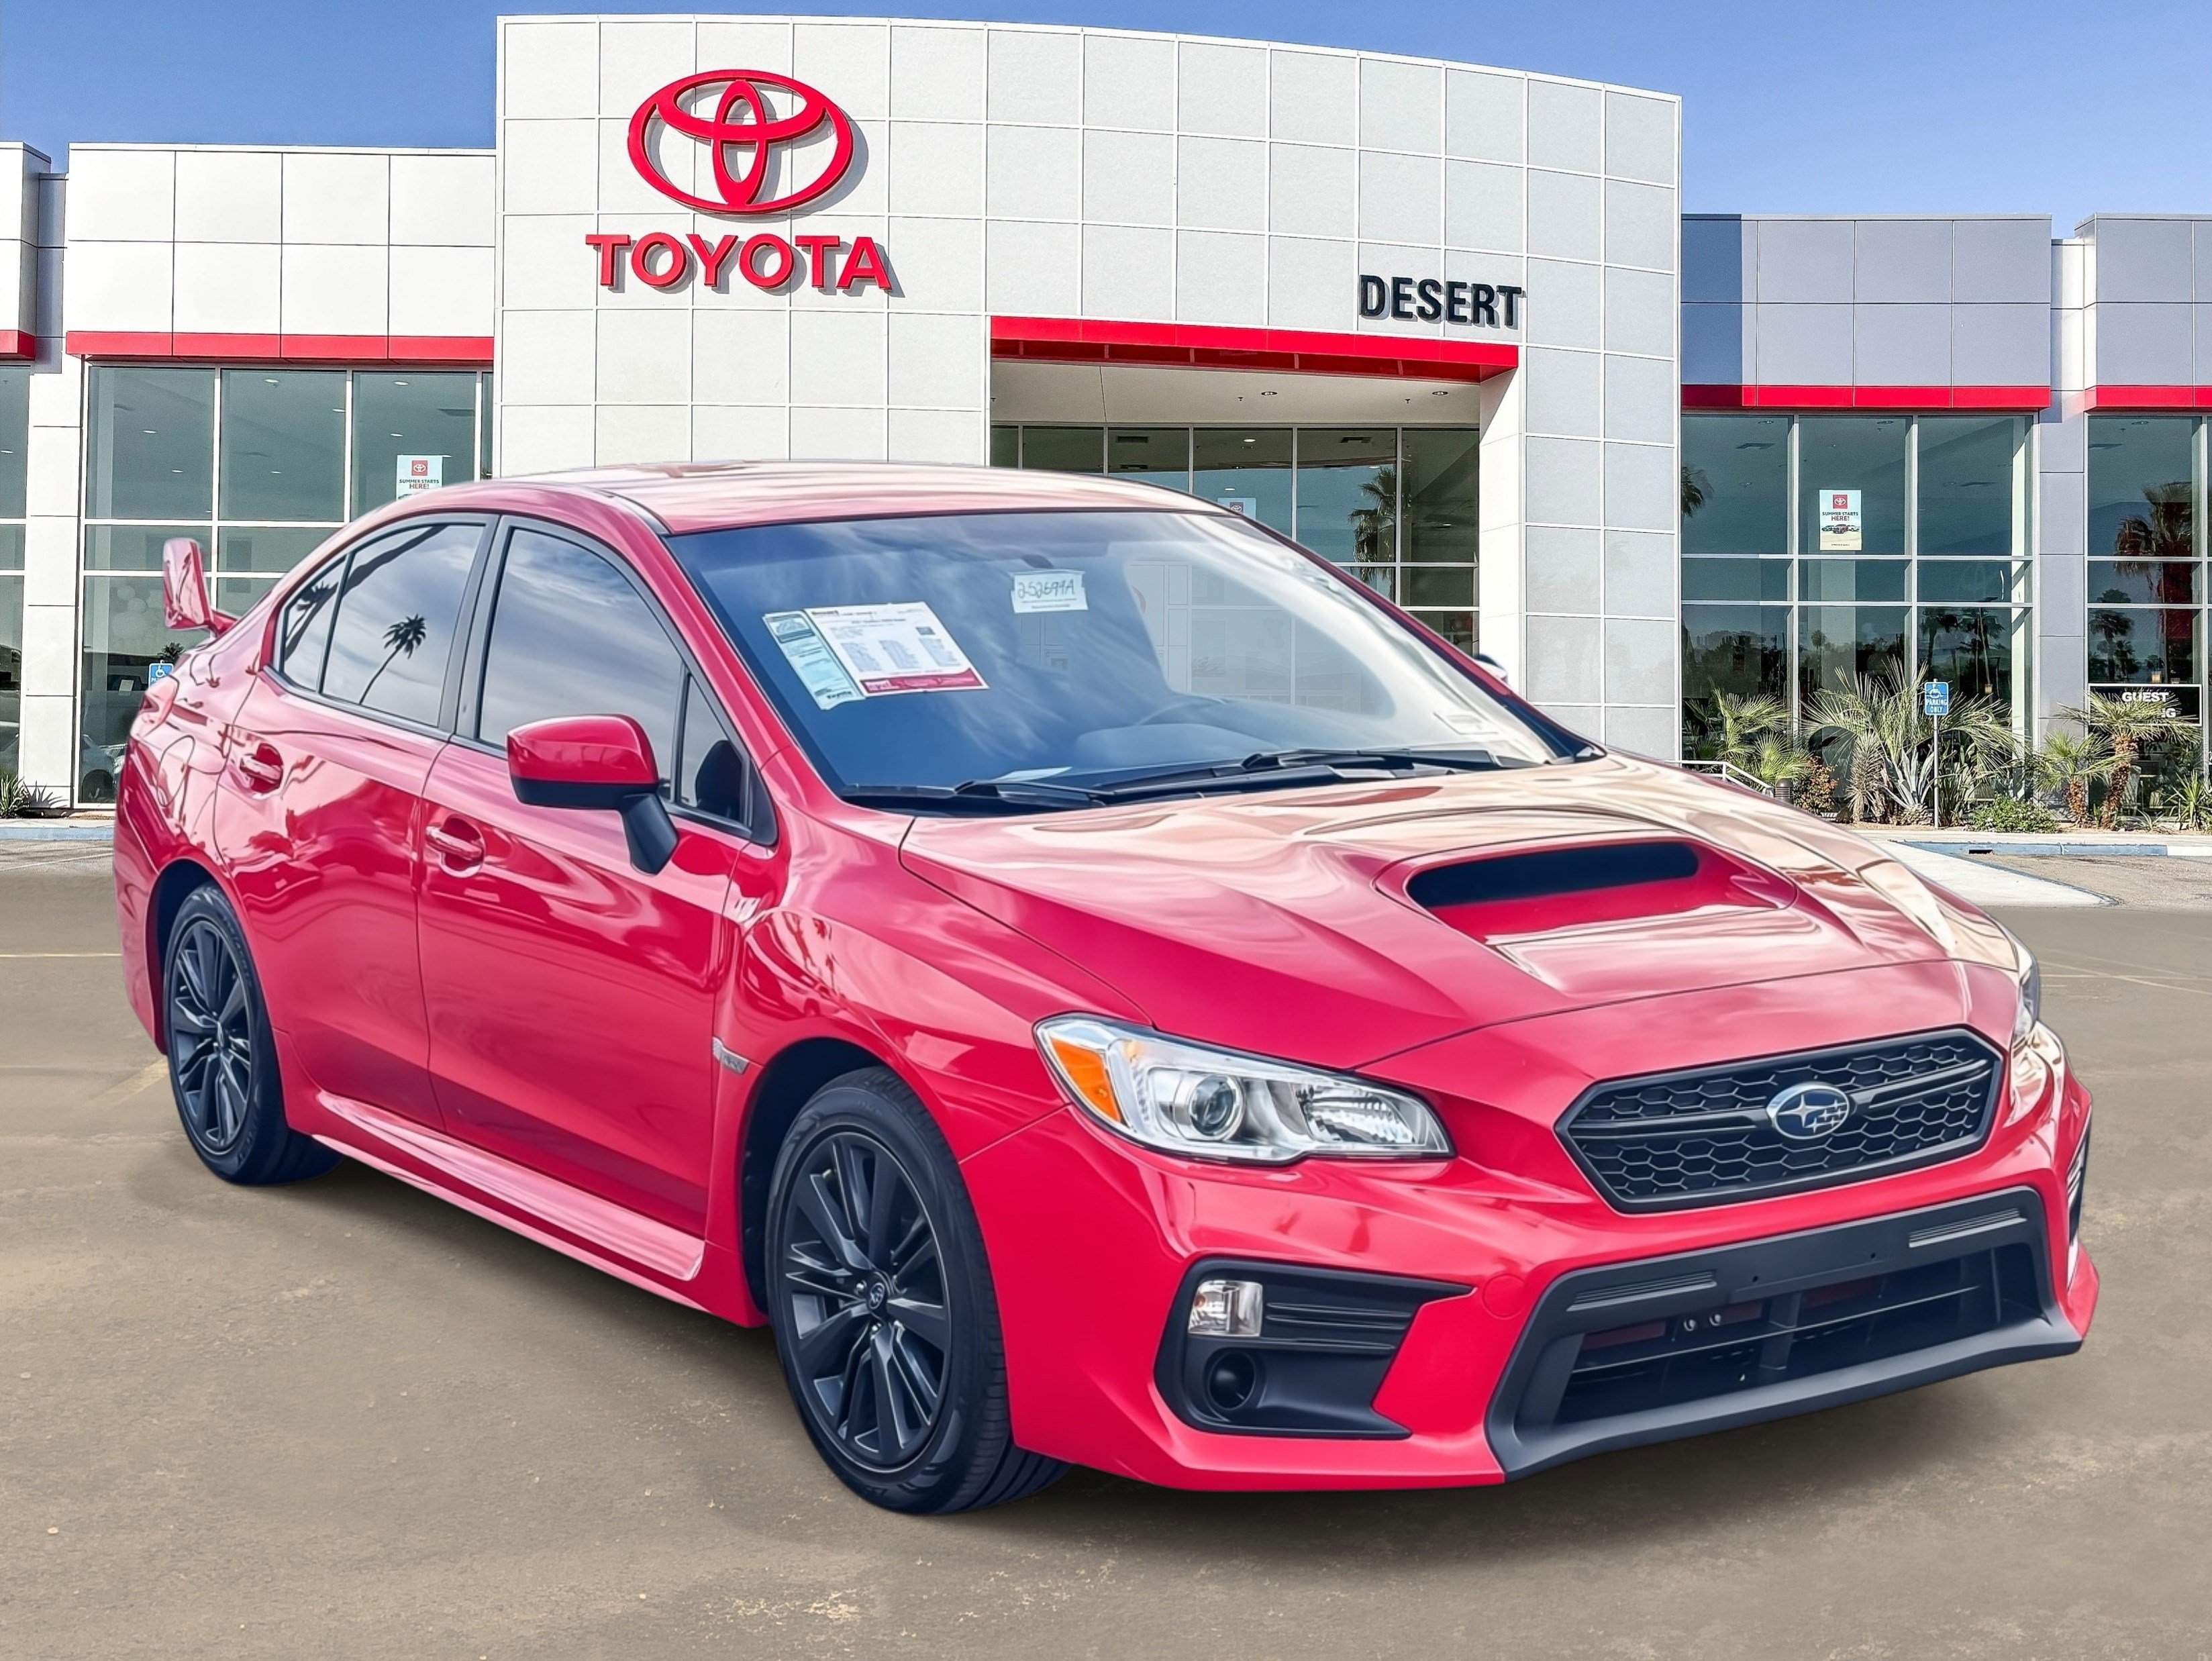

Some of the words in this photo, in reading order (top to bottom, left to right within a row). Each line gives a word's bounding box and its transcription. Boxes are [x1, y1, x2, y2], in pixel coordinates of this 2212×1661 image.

[585, 232, 892, 291] TOYOTA
[1359, 274, 1522, 327] DESERT
[2121, 691, 2169, 703] GUEST
